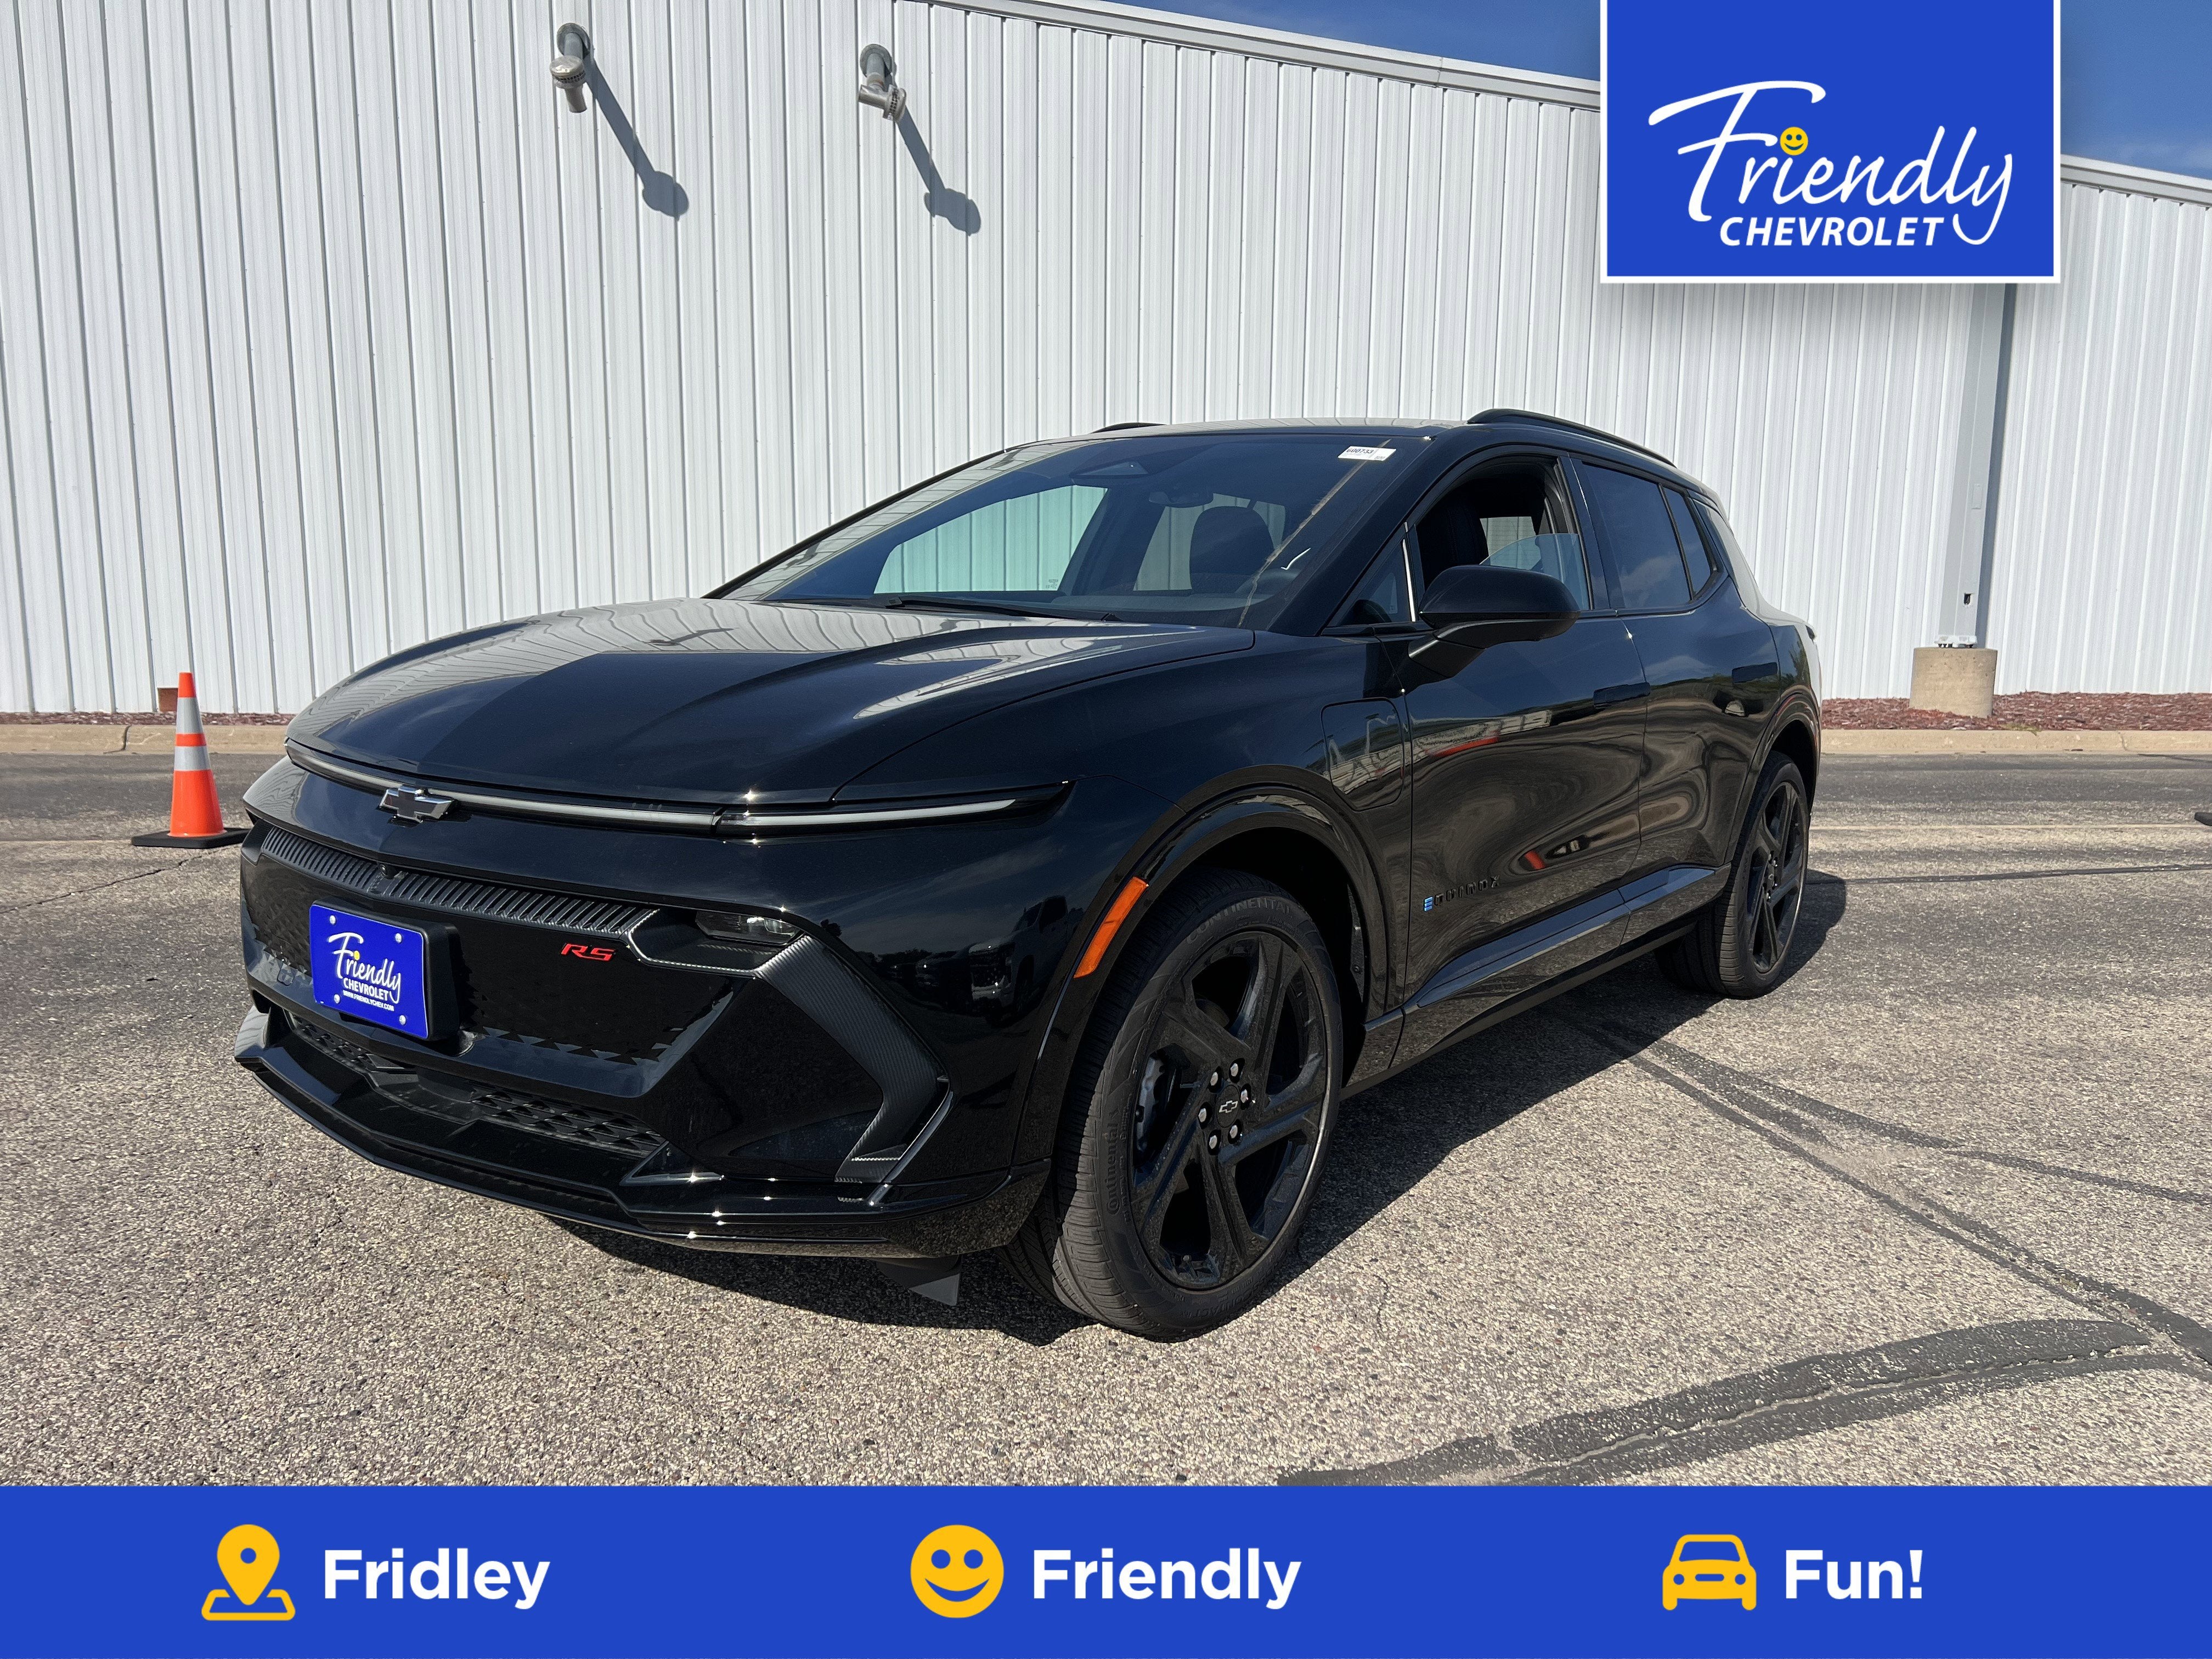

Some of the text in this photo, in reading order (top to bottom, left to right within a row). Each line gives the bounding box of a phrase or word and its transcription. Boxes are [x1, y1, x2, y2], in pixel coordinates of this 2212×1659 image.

[561, 943, 616, 961] RS
[328, 932, 402, 1004] Friendly
[343, 977, 390, 1001] CHEVROLET
